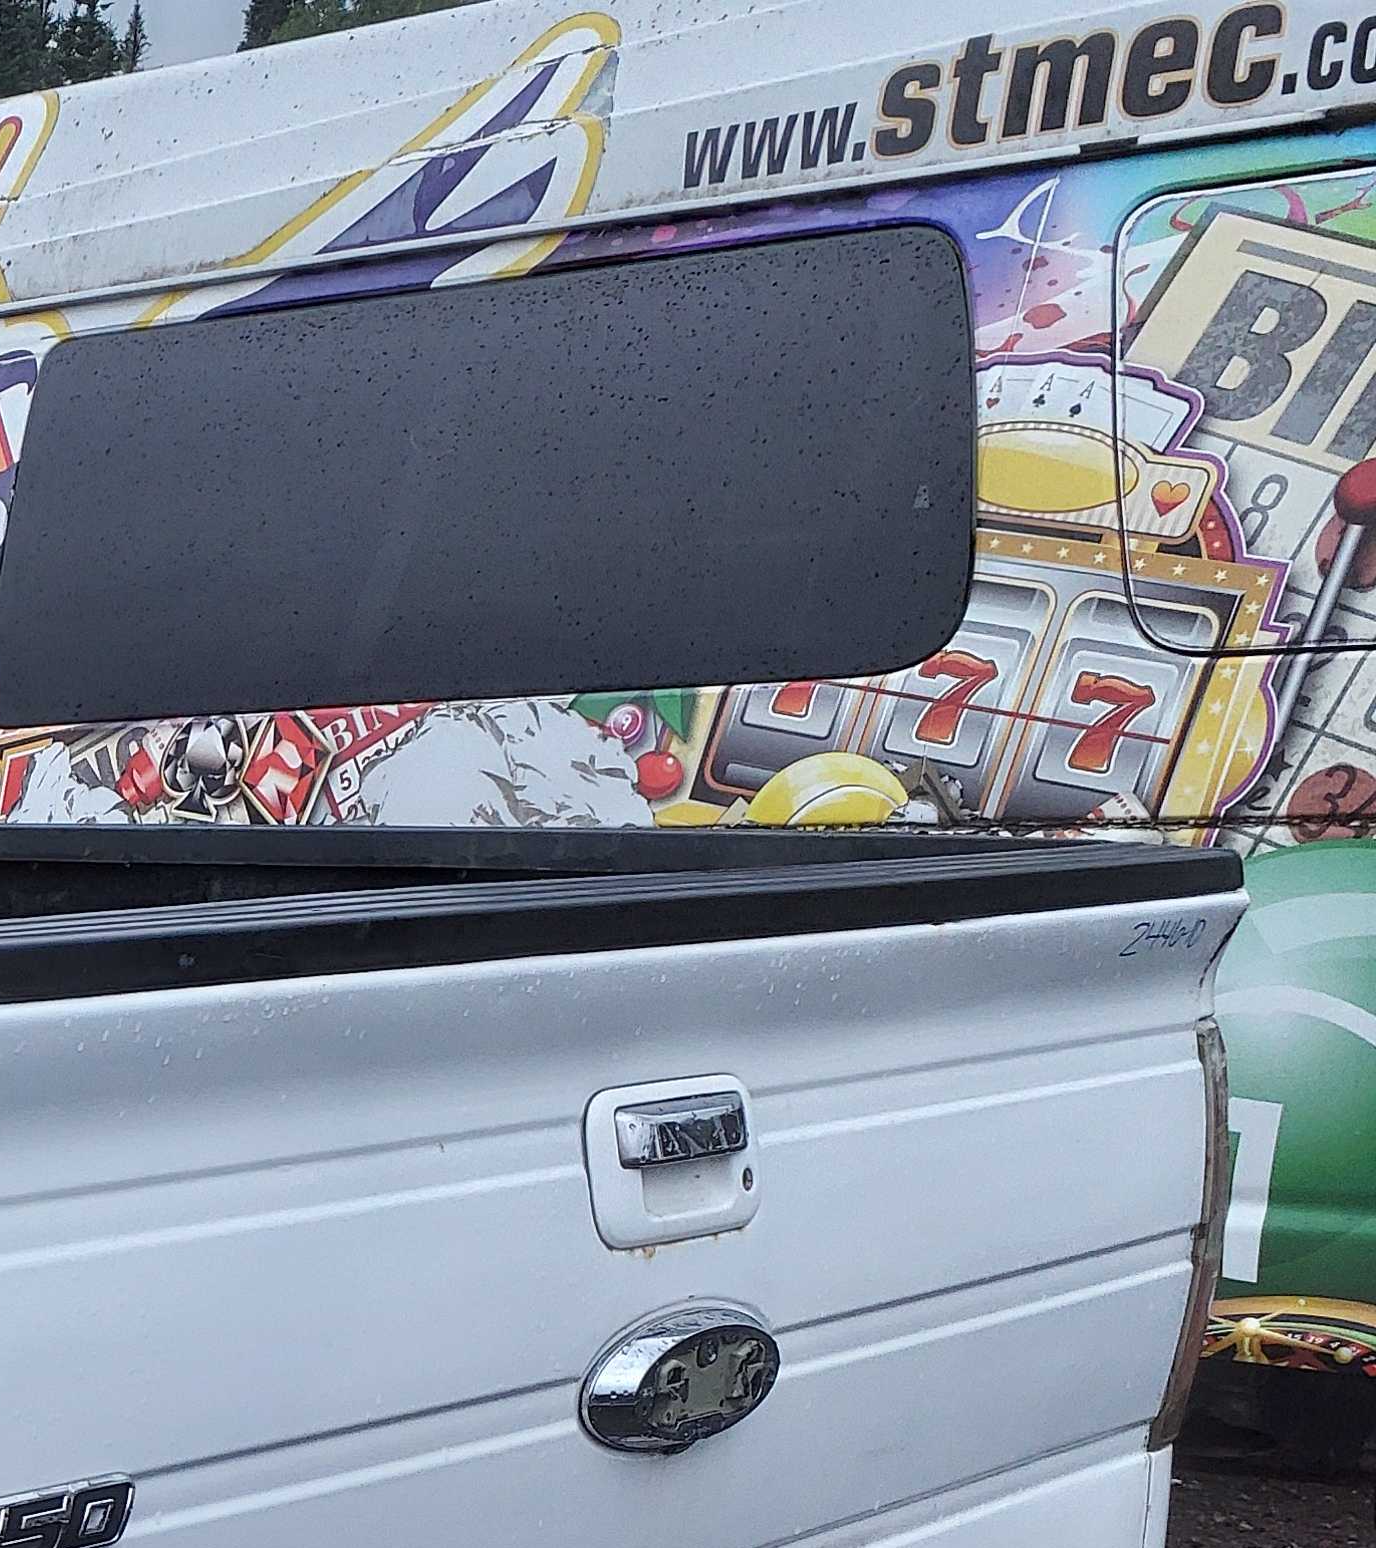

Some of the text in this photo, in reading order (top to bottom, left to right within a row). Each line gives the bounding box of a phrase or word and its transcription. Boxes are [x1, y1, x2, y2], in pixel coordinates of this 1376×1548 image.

[1175, 270, 1376, 463] BI
[1072, 671, 1156, 774] 7
[339, 769, 352, 791] 5
